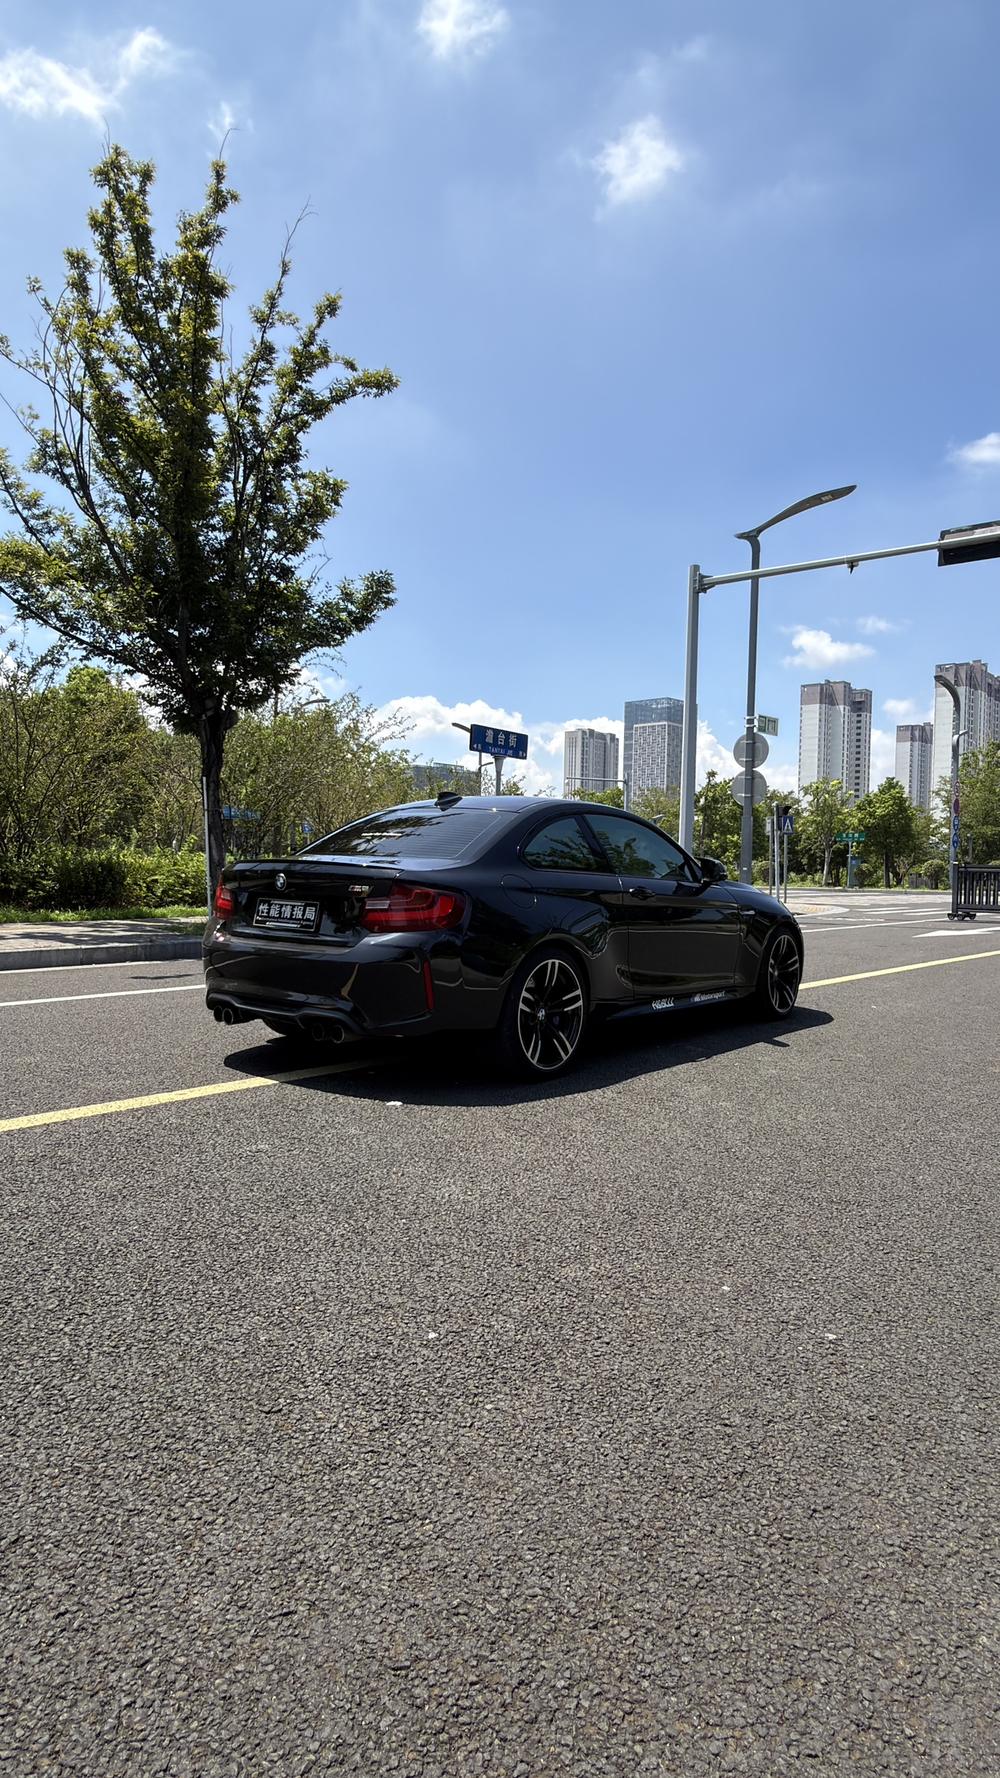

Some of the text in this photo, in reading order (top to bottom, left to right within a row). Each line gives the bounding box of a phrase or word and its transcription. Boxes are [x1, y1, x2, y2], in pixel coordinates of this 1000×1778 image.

[258, 903, 316, 921] 性能情报局
